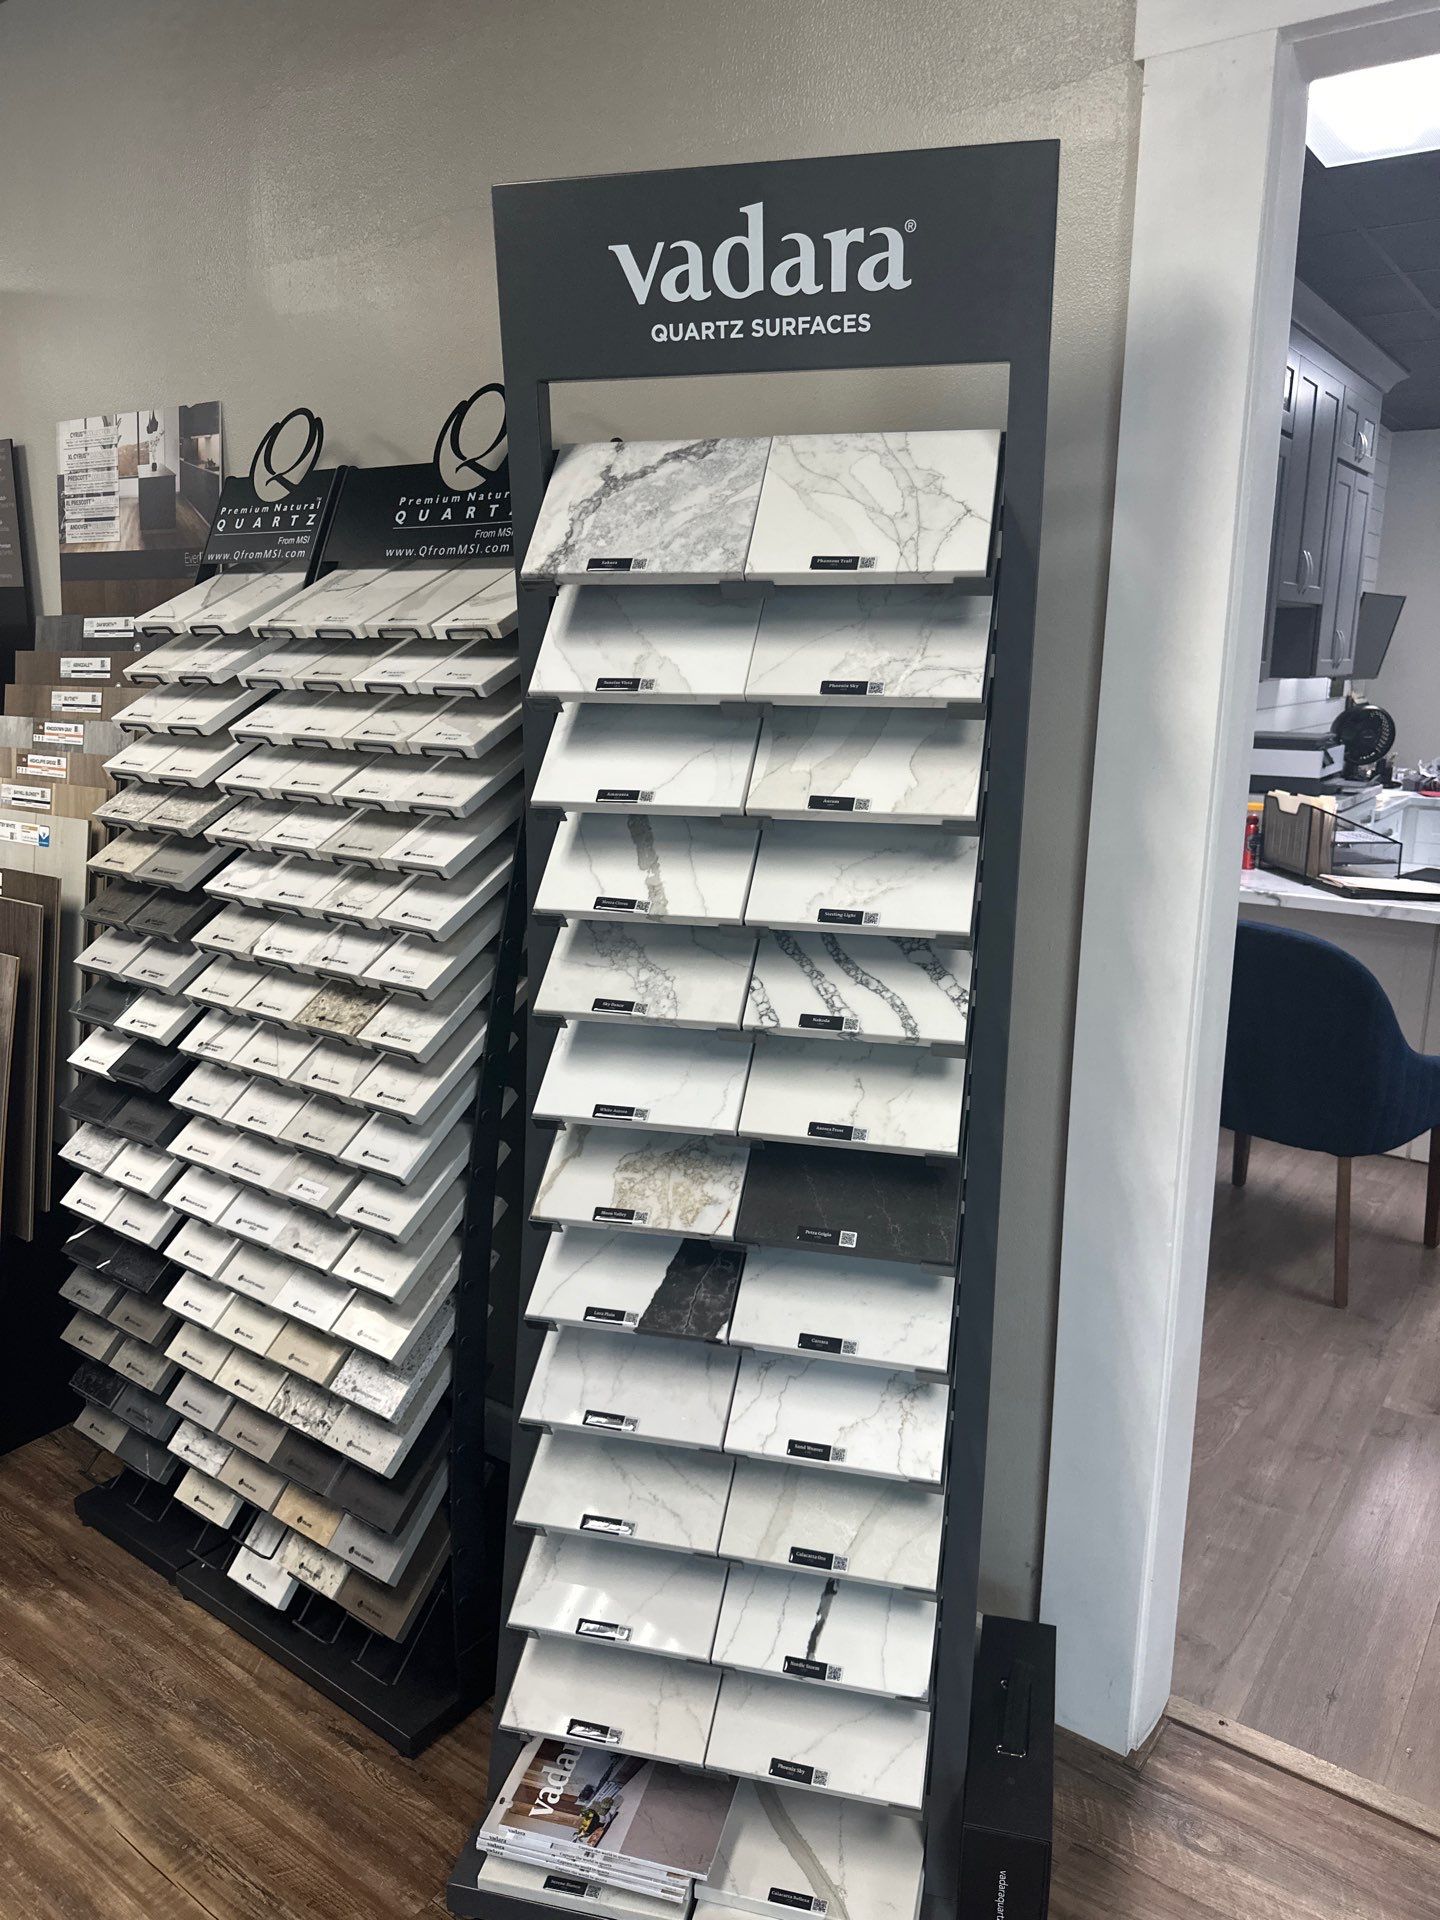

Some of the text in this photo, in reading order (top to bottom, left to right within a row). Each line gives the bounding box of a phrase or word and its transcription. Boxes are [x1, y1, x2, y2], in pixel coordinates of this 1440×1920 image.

[650, 313, 871, 342] QUARTZ SURFACES
[399, 491, 511, 506] Premium Natur
[220, 500, 322, 516] Premium Natural
[395, 504, 512, 525] QUART
[216, 514, 317, 532] QUARTZ
[278, 536, 310, 545] From MSI
[474, 529, 496, 538] From
[207, 549, 306, 560] www.QfromMSI.com
[385, 544, 510, 558] www.QfromMSI.com
[528, 1743, 584, 1816] vadar
